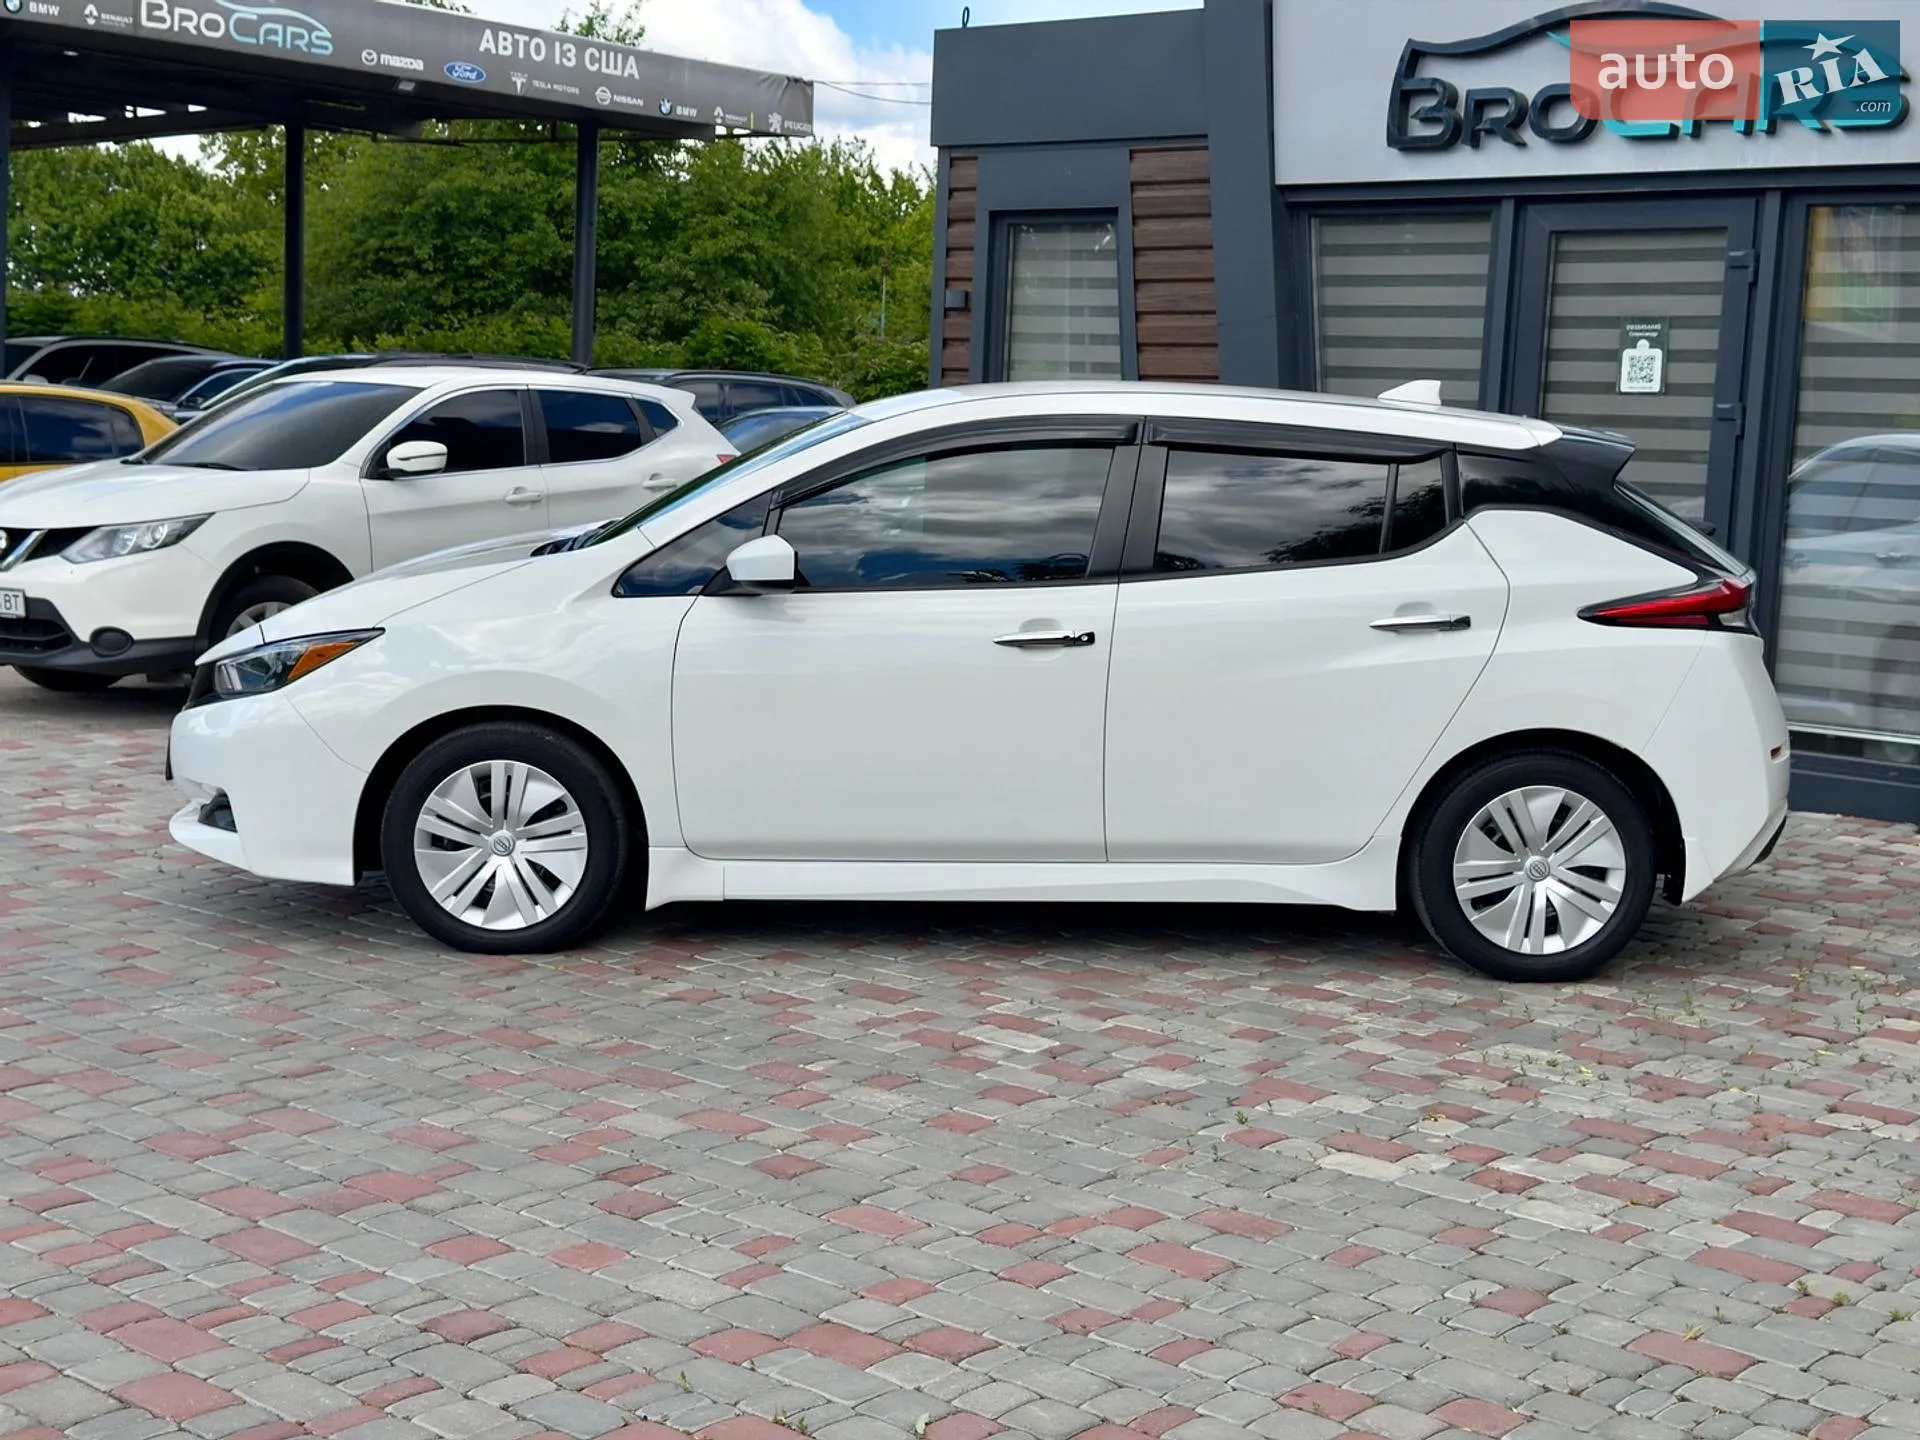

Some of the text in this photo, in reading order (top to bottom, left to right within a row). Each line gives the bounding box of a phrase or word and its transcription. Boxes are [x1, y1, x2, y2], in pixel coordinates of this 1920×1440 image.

[29, 1, 60, 16] BMW
[478, 28, 547, 62] АВТО
[584, 46, 641, 81] США
[613, 94, 644, 107] NISSAN
[676, 105, 698, 118] BMW
